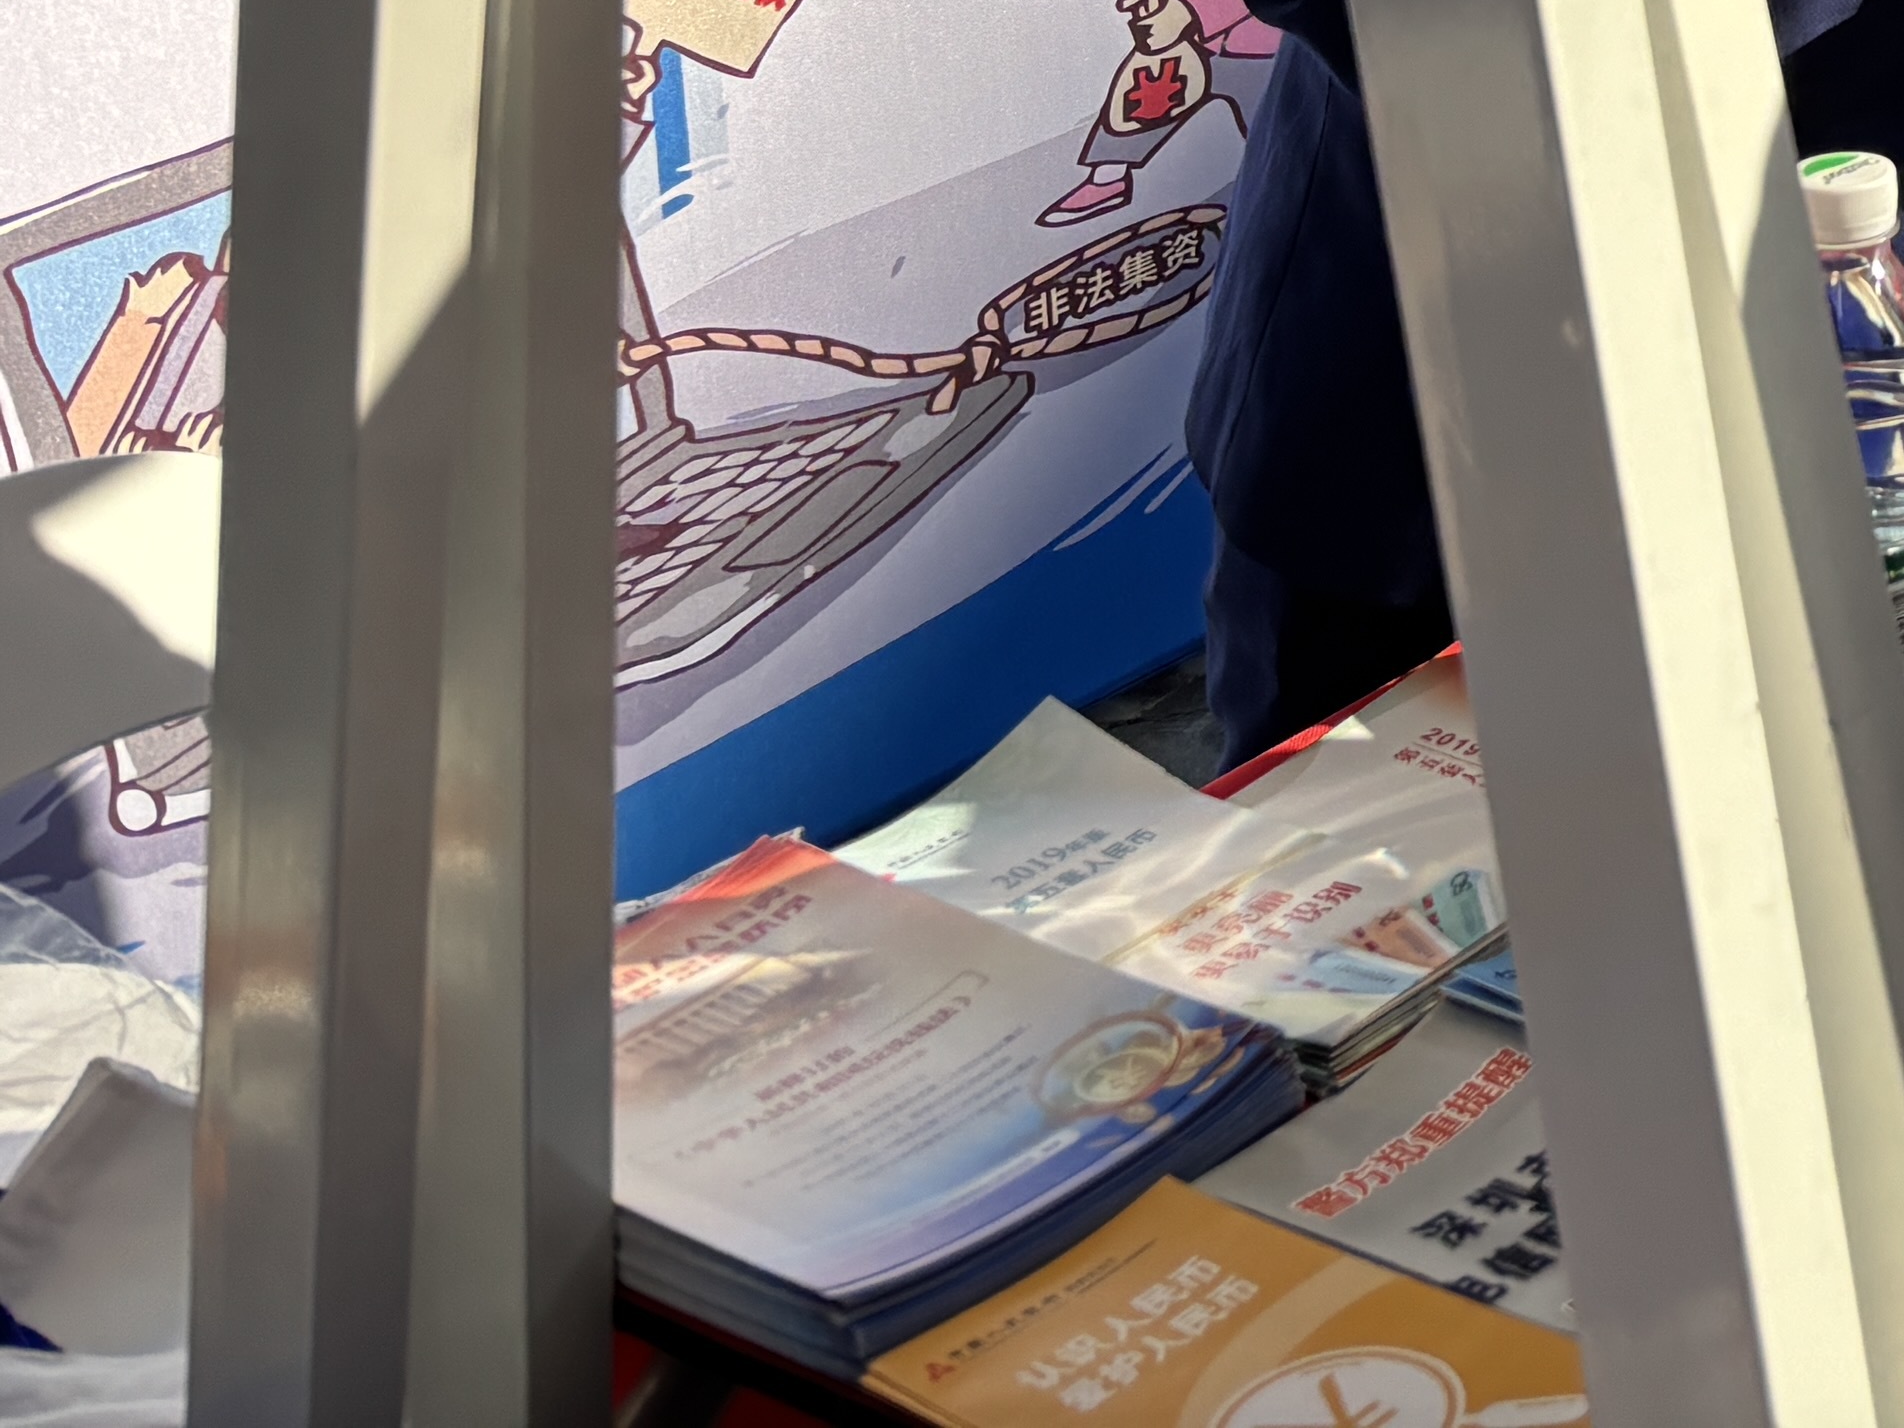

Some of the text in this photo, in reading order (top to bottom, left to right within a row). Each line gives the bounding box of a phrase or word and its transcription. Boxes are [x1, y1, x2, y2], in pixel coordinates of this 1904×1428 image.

[1024, 227, 1204, 335] 非法集资
[1292, 1047, 1533, 1219] 警方郑重提醒
